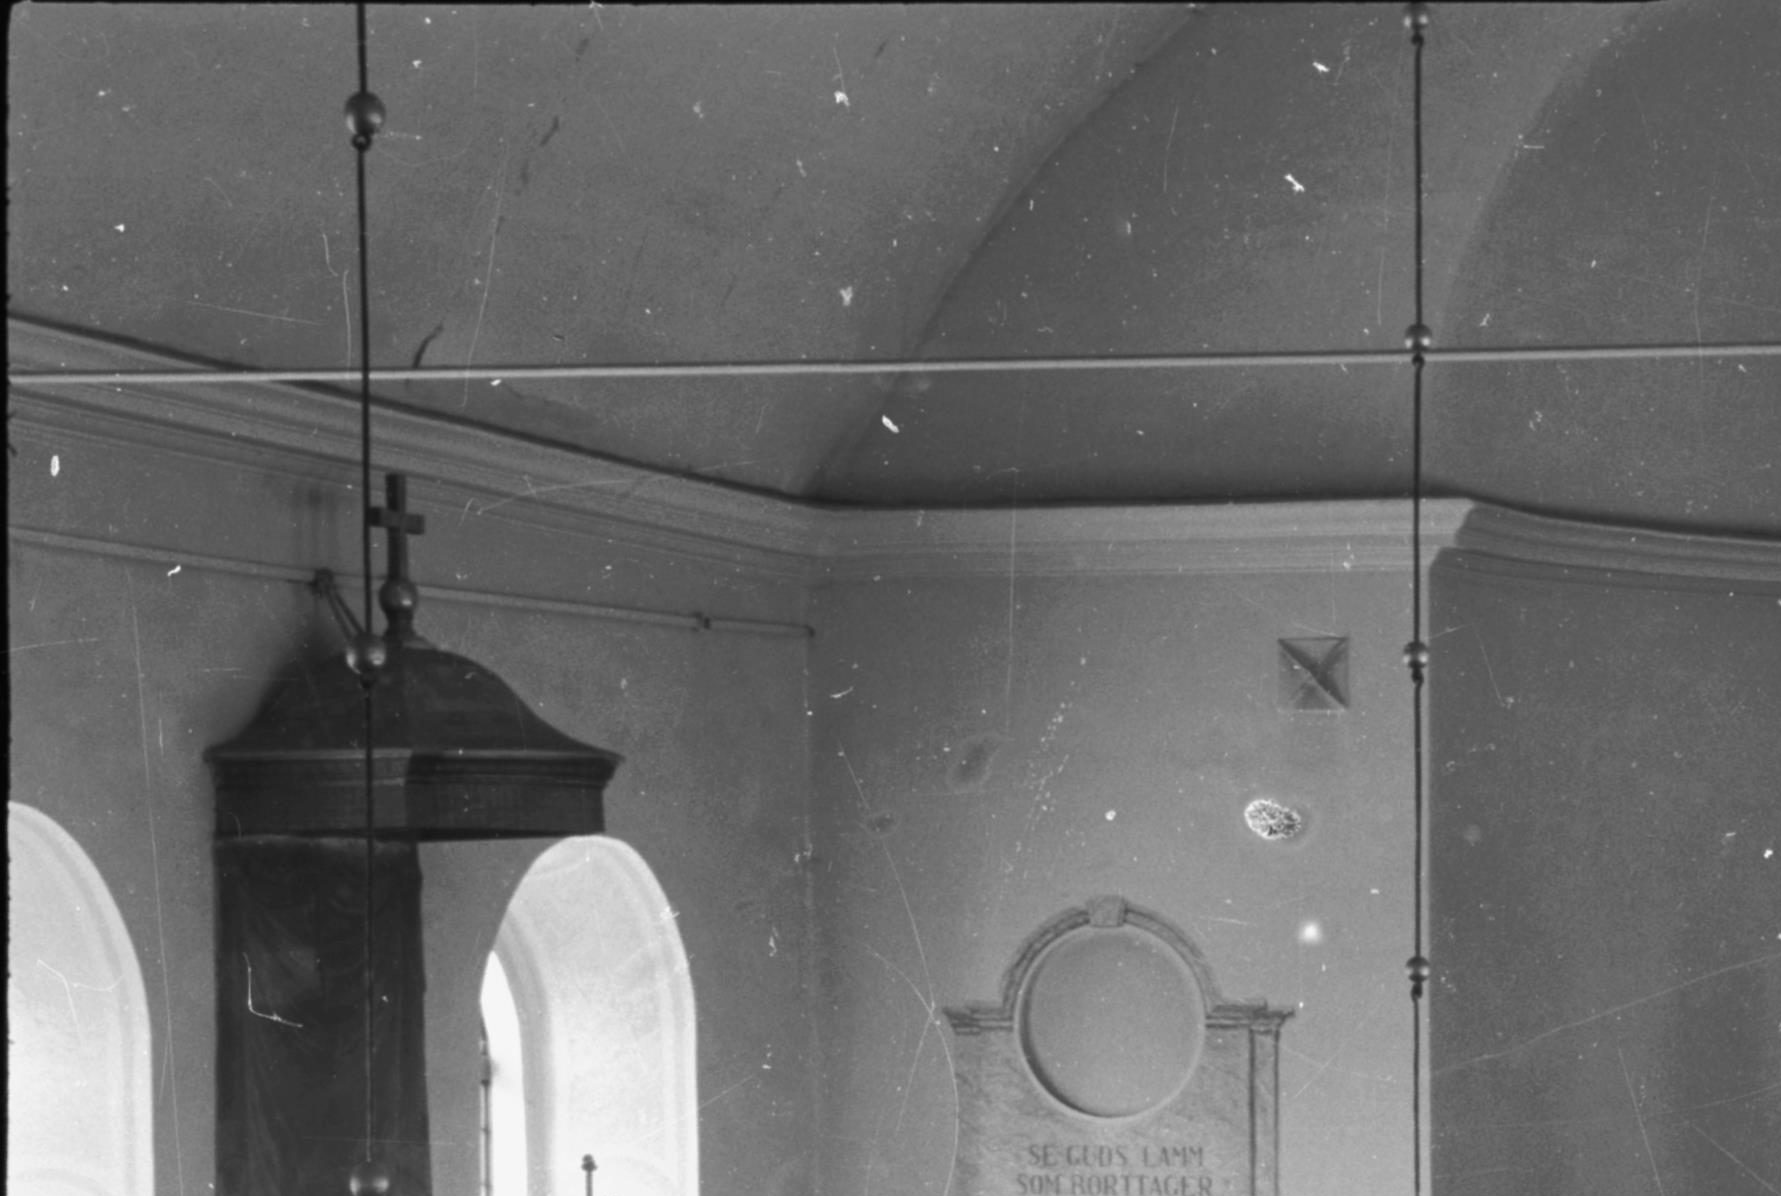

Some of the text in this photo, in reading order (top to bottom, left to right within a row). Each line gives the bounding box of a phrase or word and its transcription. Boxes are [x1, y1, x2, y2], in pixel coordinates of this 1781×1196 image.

[1027, 1143, 1204, 1168] SE GUDS LAMM
[1016, 1172, 1062, 1196] SOM
